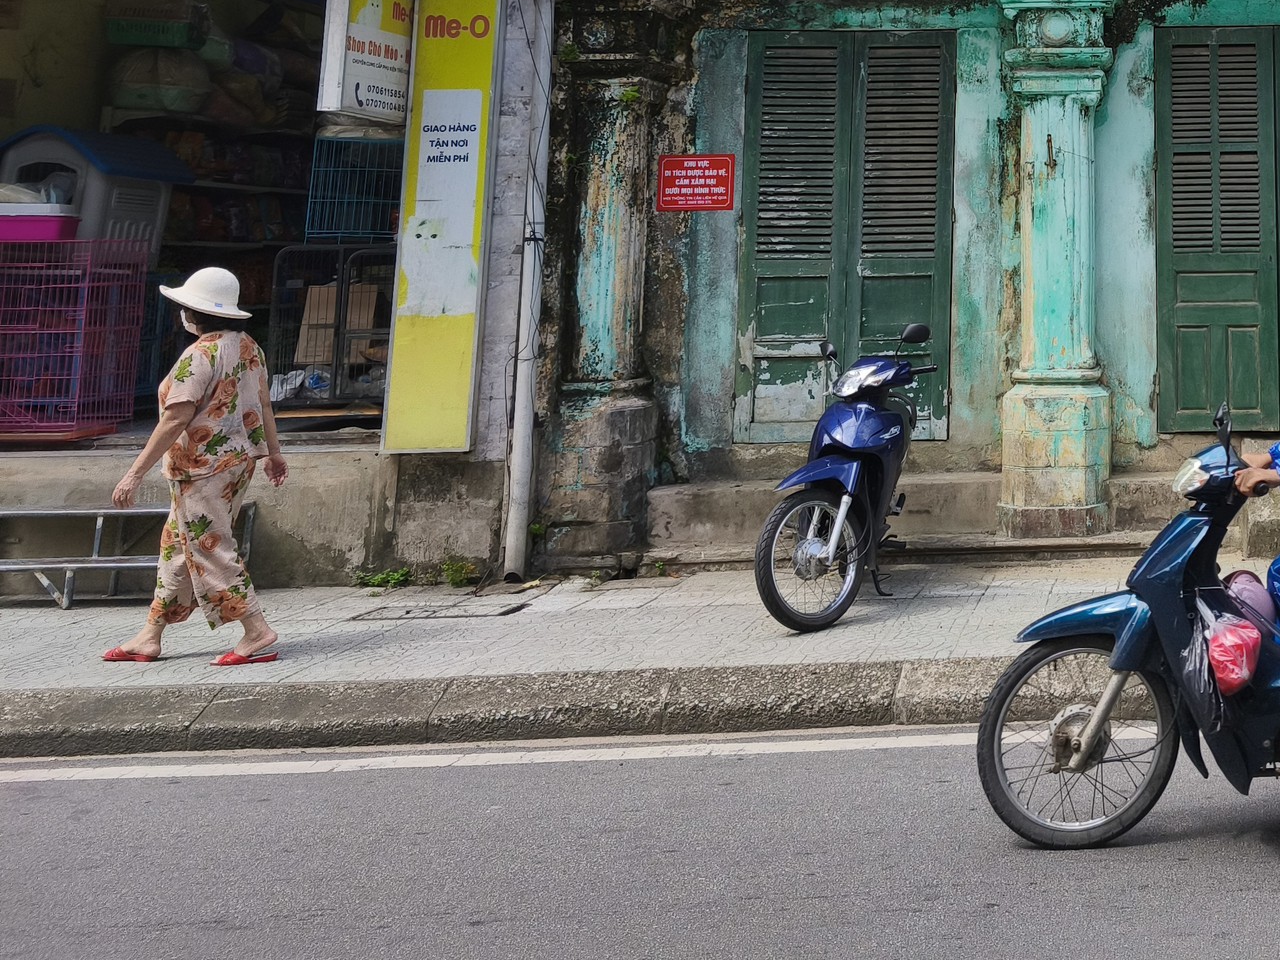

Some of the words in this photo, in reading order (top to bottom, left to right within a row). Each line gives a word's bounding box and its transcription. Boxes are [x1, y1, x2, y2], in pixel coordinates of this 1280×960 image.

[425, 14, 490, 38] Me-O
[347, 35, 365, 54] Shop
[422, 124, 447, 133] GIAO
[448, 122, 477, 132] HÀNG
[429, 137, 449, 150] TẬN
[450, 138, 469, 147] NƠI
[426, 151, 451, 163] MIỄN
[453, 152, 469, 163] PHÍ
